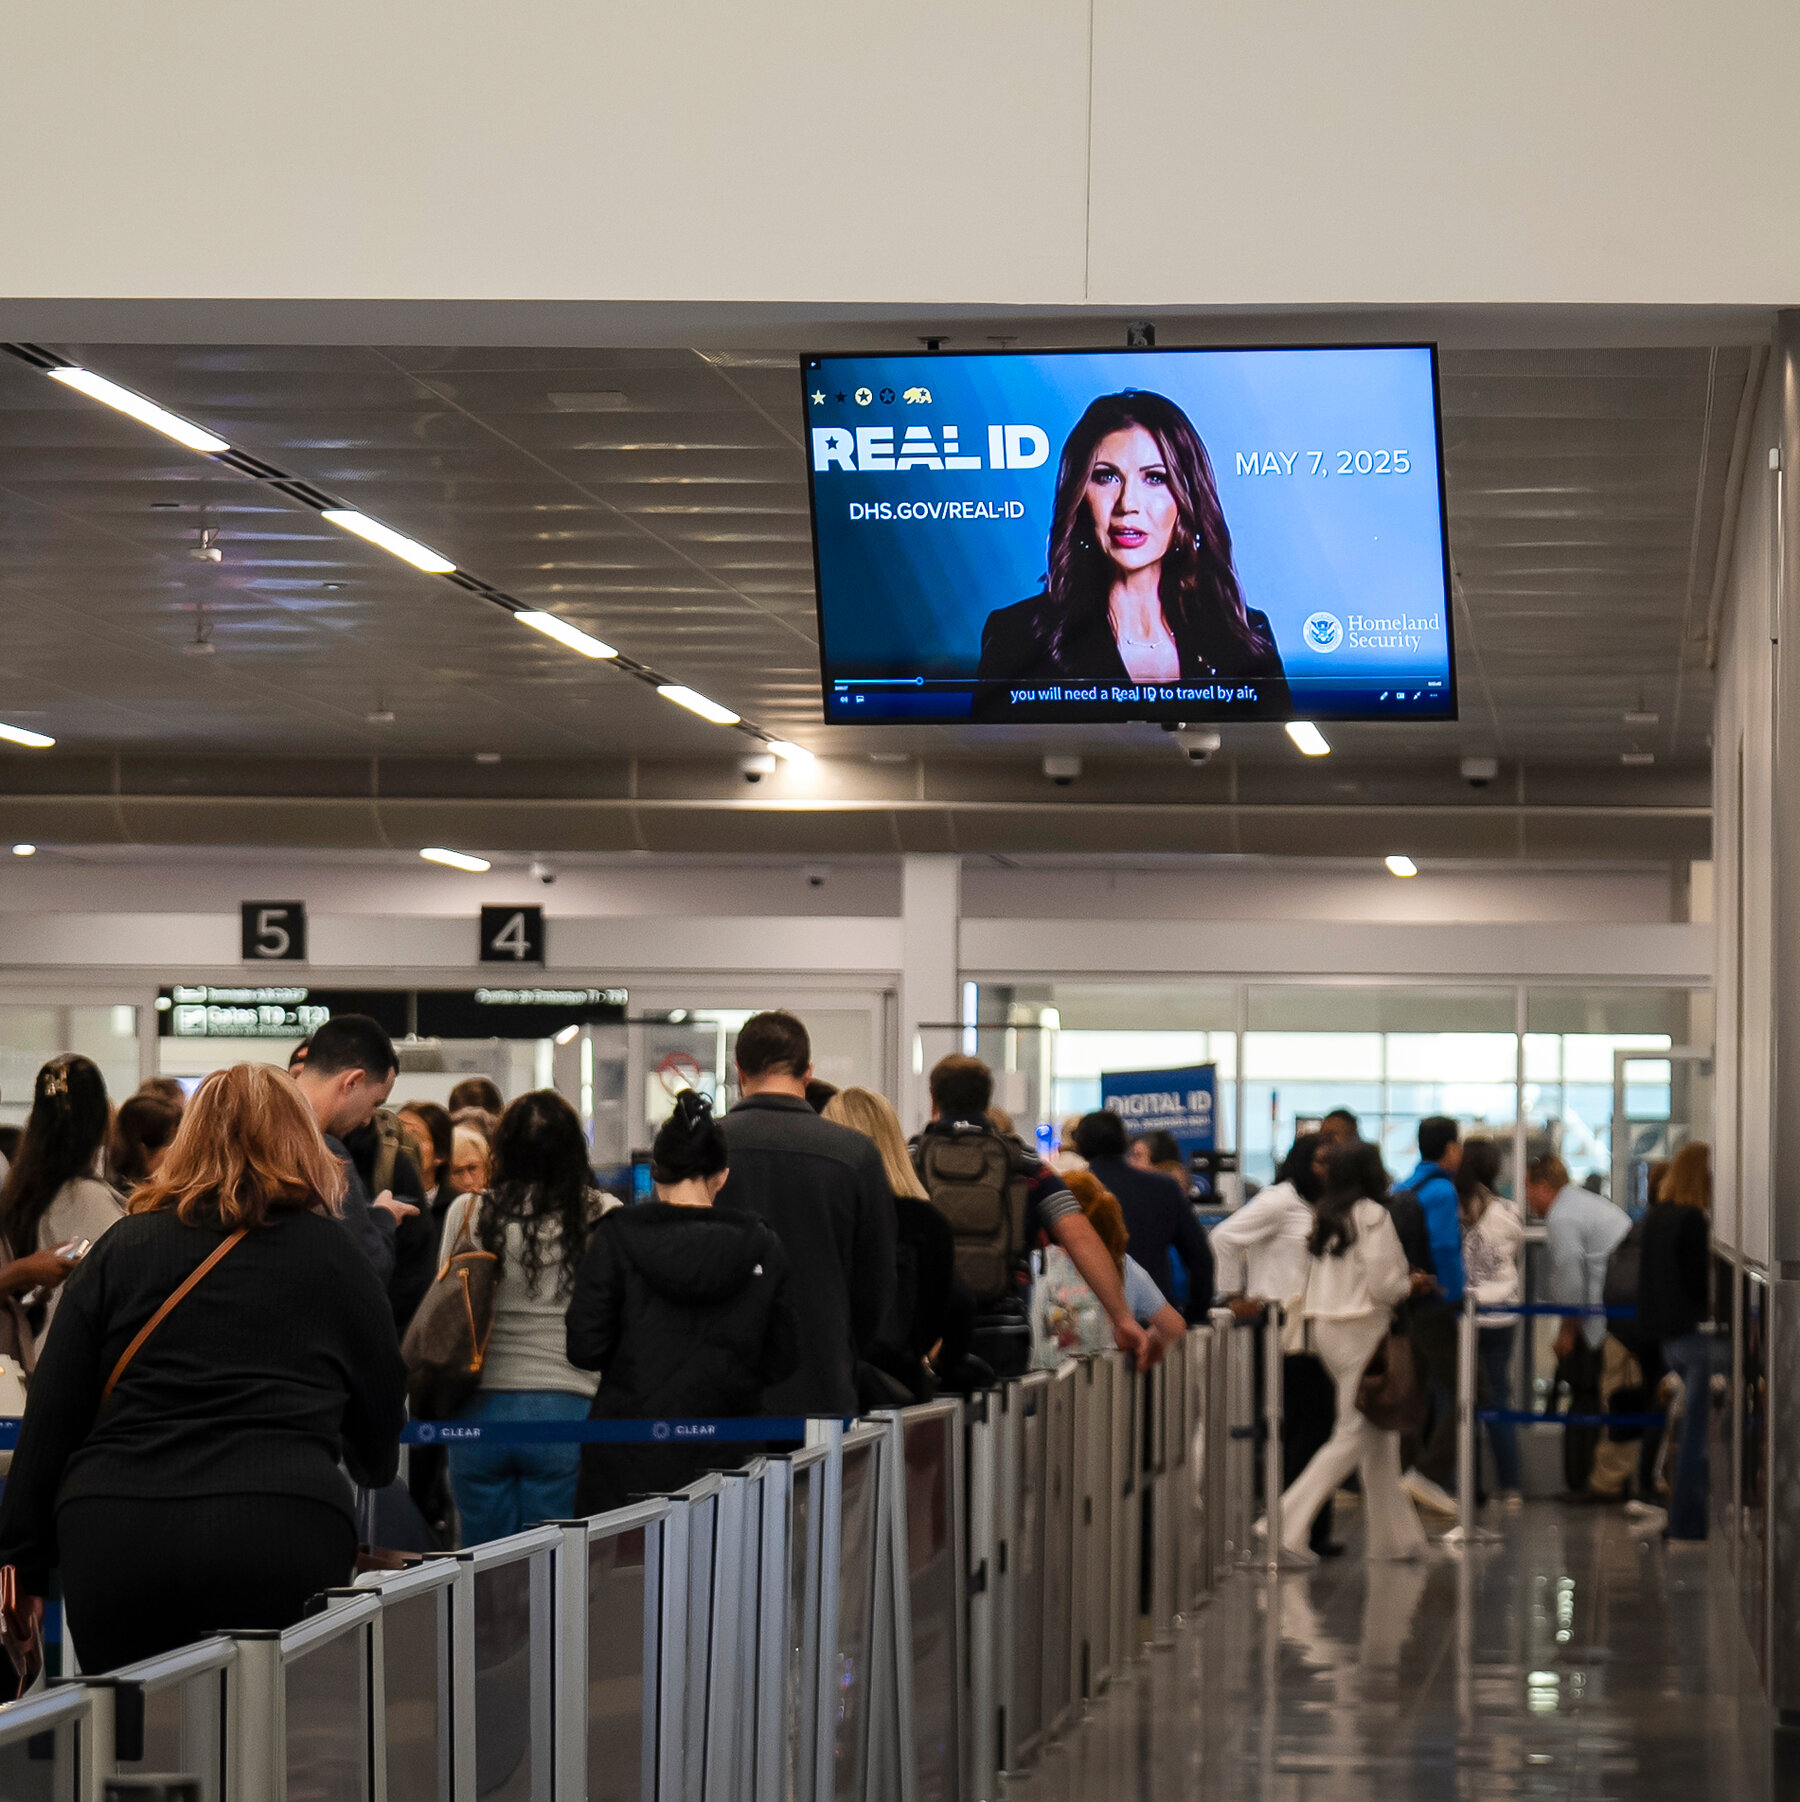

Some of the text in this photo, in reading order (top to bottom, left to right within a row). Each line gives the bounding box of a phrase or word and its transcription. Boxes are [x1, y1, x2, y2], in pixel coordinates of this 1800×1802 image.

[812, 424, 1050, 471] REAL ID
[1236, 450, 1412, 478] MAY 7, 2025
[849, 501, 1025, 520] DHS.GOV/REAL-ID
[1347, 613, 1440, 631] Homeland
[1348, 632, 1421, 653] Security
[1010, 685, 1258, 704] you will need a Real ID to travel by air,
[255, 909, 290, 959] 5
[491, 911, 532, 960] 4
[1105, 1089, 1212, 1115] DIGITAL ID
[440, 1427, 482, 1438] CLEAR
[675, 1425, 716, 1435] CLEAR
